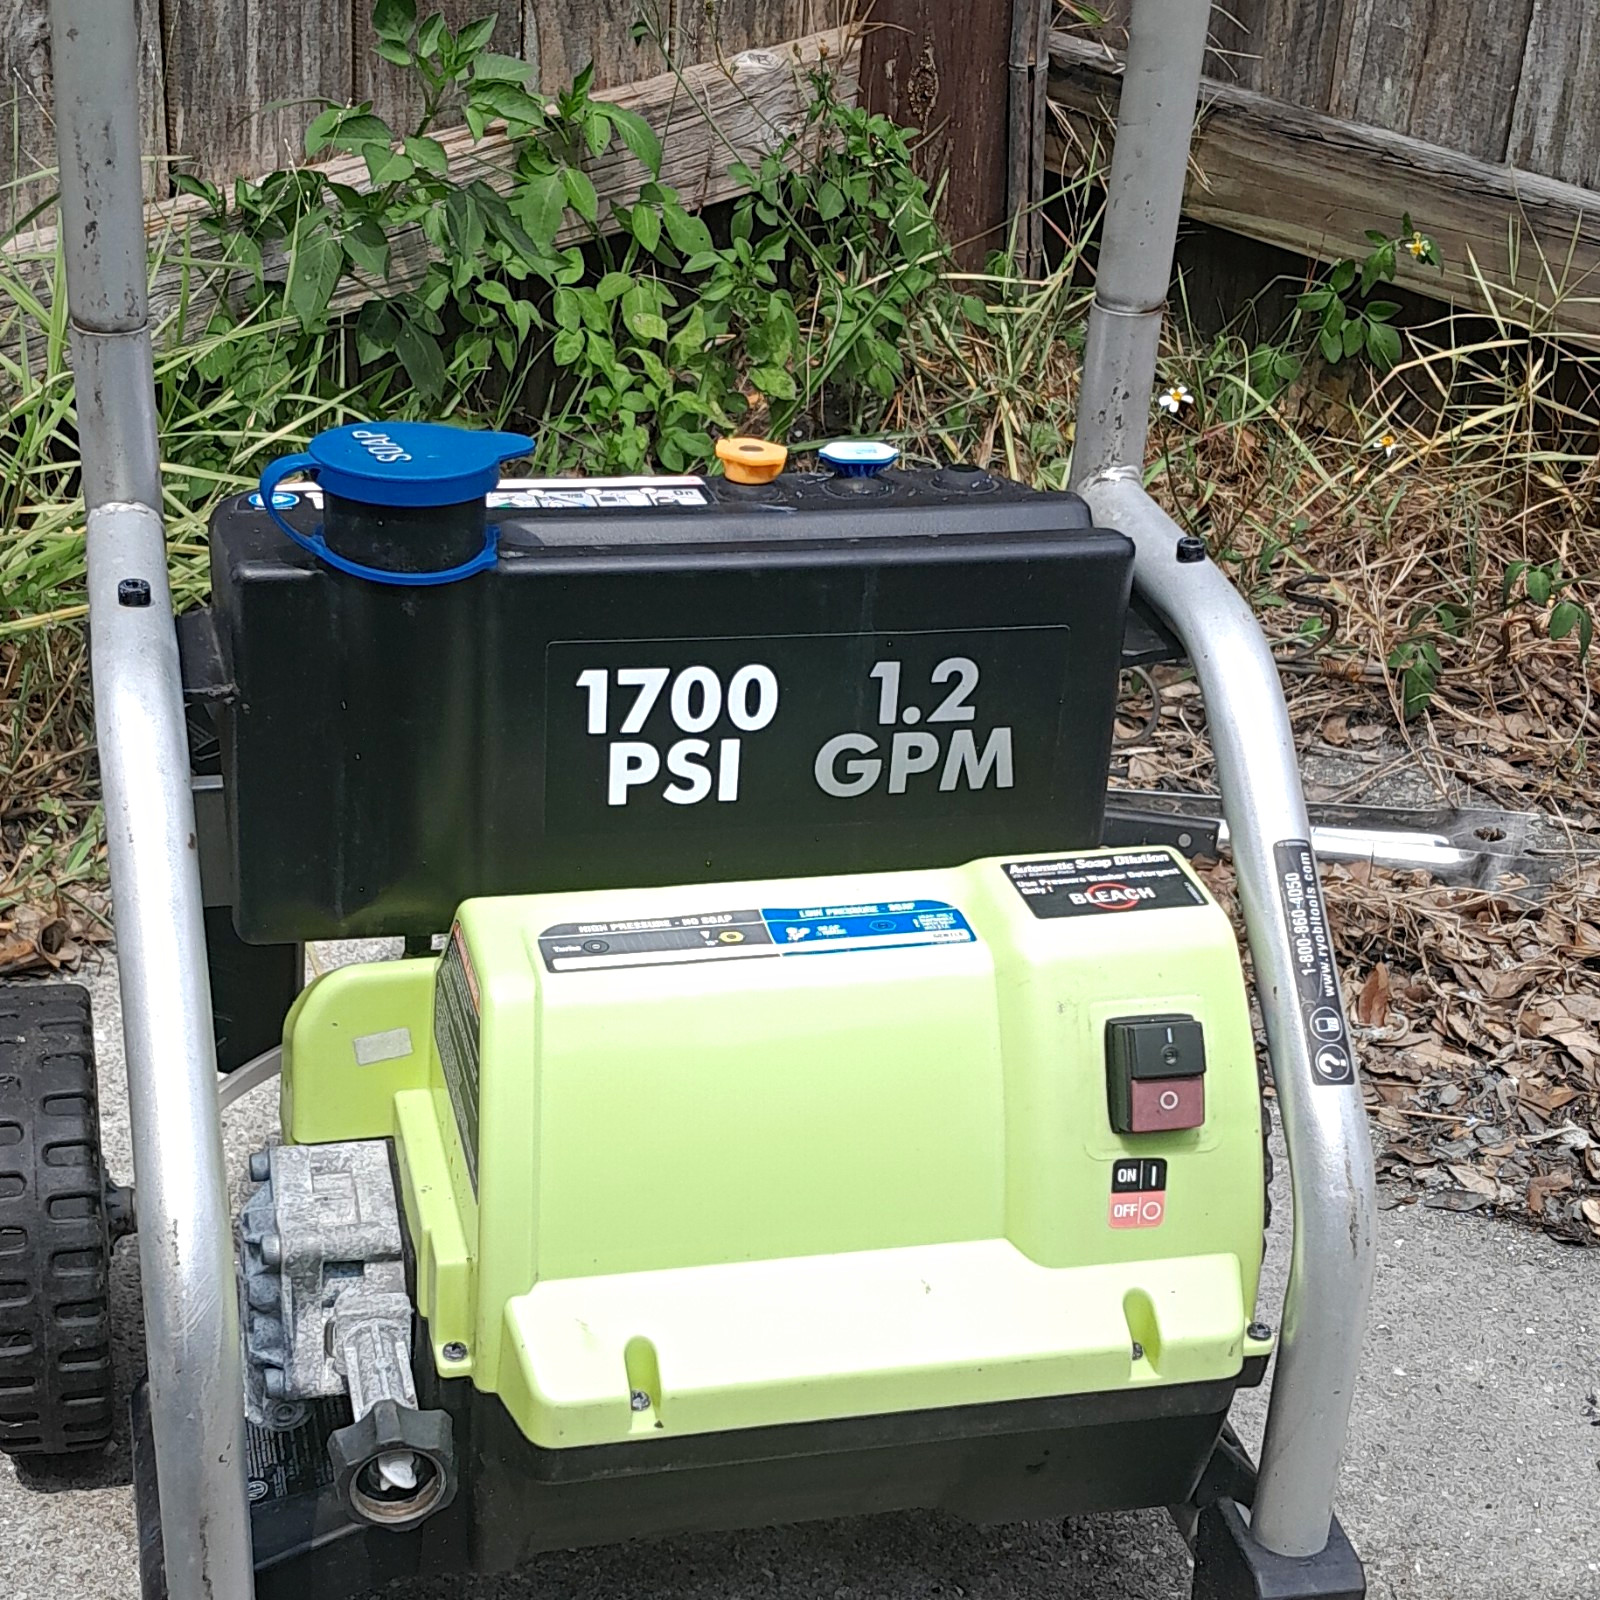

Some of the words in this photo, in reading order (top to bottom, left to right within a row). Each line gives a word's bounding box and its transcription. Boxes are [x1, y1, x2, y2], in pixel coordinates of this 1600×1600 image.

[351, 430, 412, 462] SOAP
[576, 664, 778, 733] 1700
[870, 657, 979, 725] 1.2
[608, 738, 740, 805] PSI
[814, 727, 1013, 797] GPM
[1009, 861, 1074, 874] Automatic
[1075, 859, 1112, 870] Soap
[1113, 853, 1170, 866] Dilution
[1038, 876, 1087, 886] Pressure
[1086, 873, 1126, 883] Washer
[1126, 868, 1181, 878] Detergent
[1068, 886, 1157, 906] BLEACH
[578, 923, 608, 933] HIGH
[610, 919, 672, 932] PRESSURE
[682, 918, 700, 927] NO
[701, 914, 733, 925] SOAP
[1285, 872, 1317, 976] 1-800-860-4050
[1300, 851, 1336, 997] www.ryobitools.com
[1117, 1167, 1137, 1183] ON
[1113, 1203, 1138, 1219] OFF
